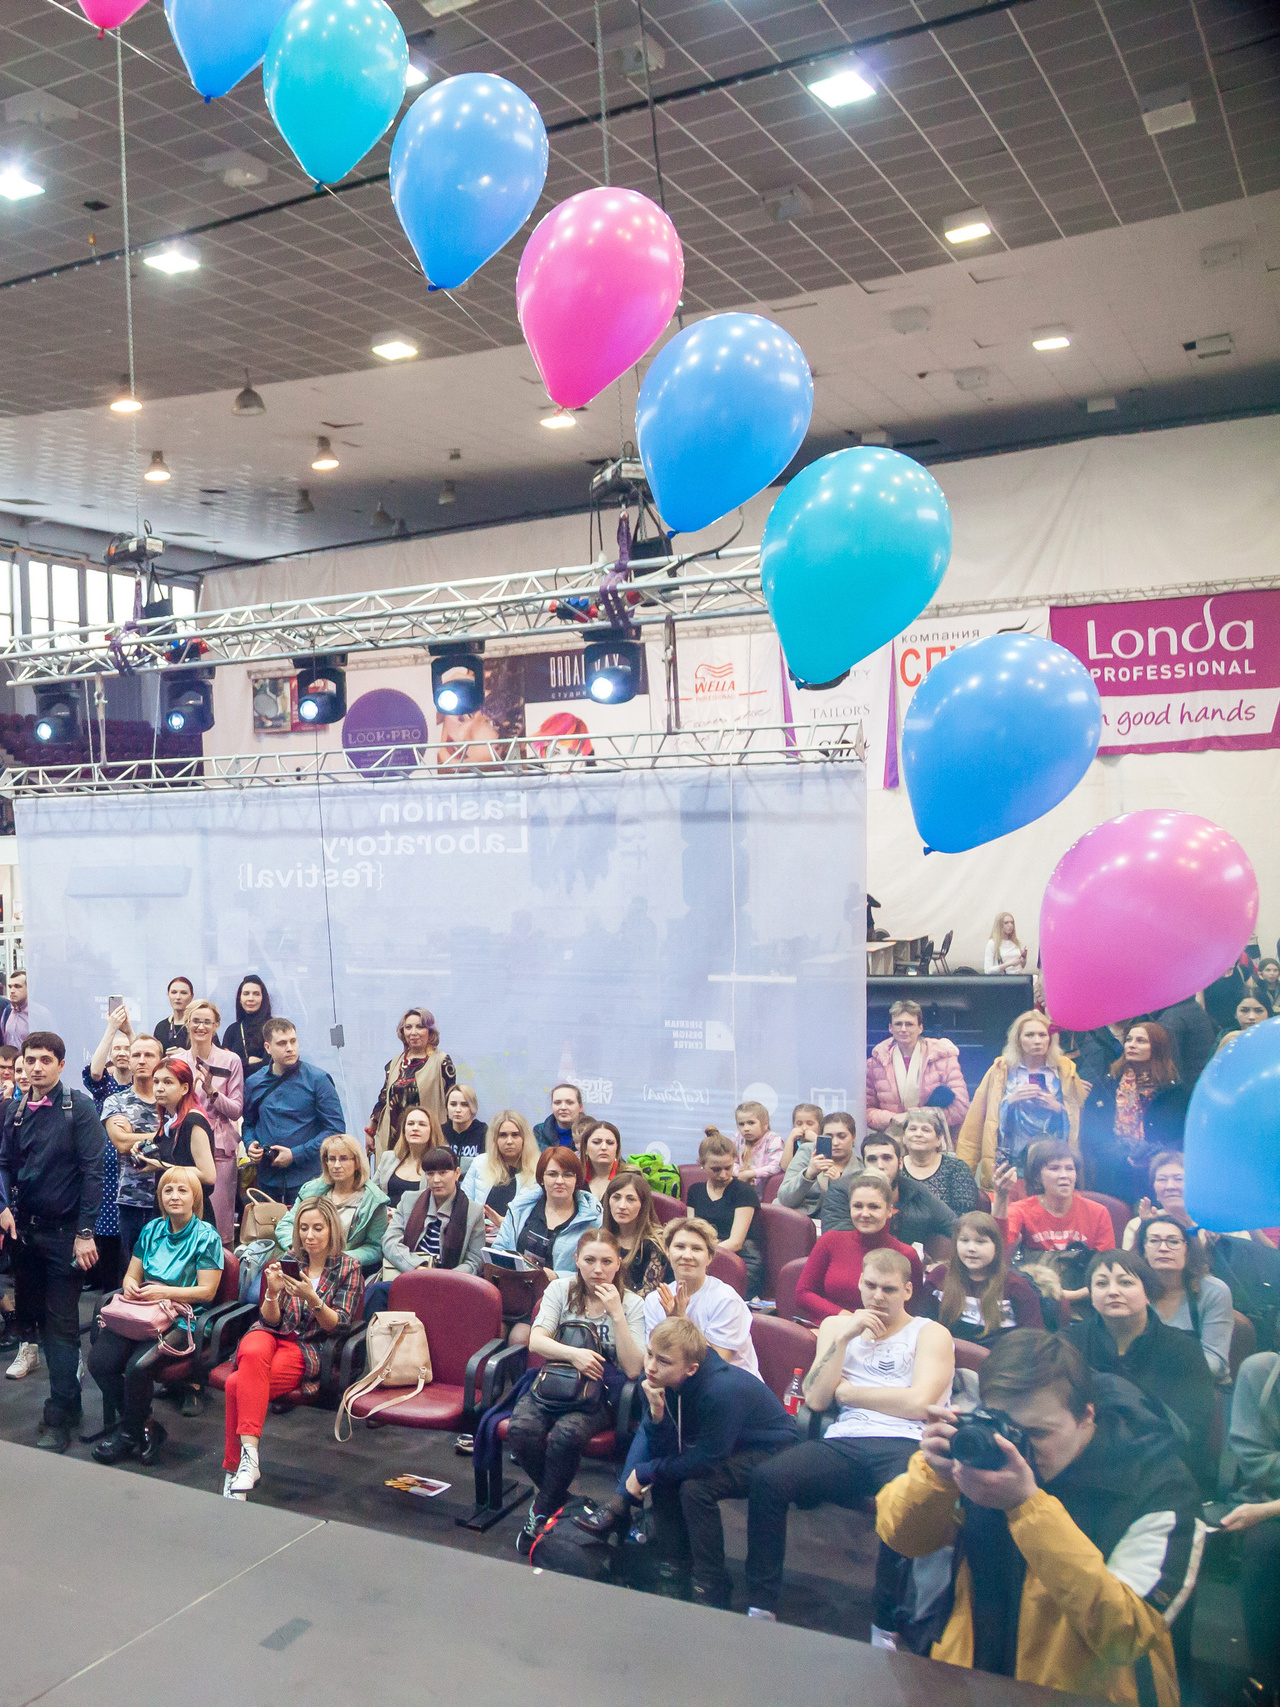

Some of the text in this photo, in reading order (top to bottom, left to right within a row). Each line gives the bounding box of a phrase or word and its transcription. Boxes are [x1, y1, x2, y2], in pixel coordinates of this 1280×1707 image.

[901, 629, 980, 645] компания
[1087, 598, 1255, 660] Londa
[1090, 659, 1256, 682] PROFESSIONAL
[695, 681, 735, 694] WELLA
[810, 704, 871, 719] TAILORS
[1117, 703, 1171, 736] good
[1180, 699, 1256, 726] hands
